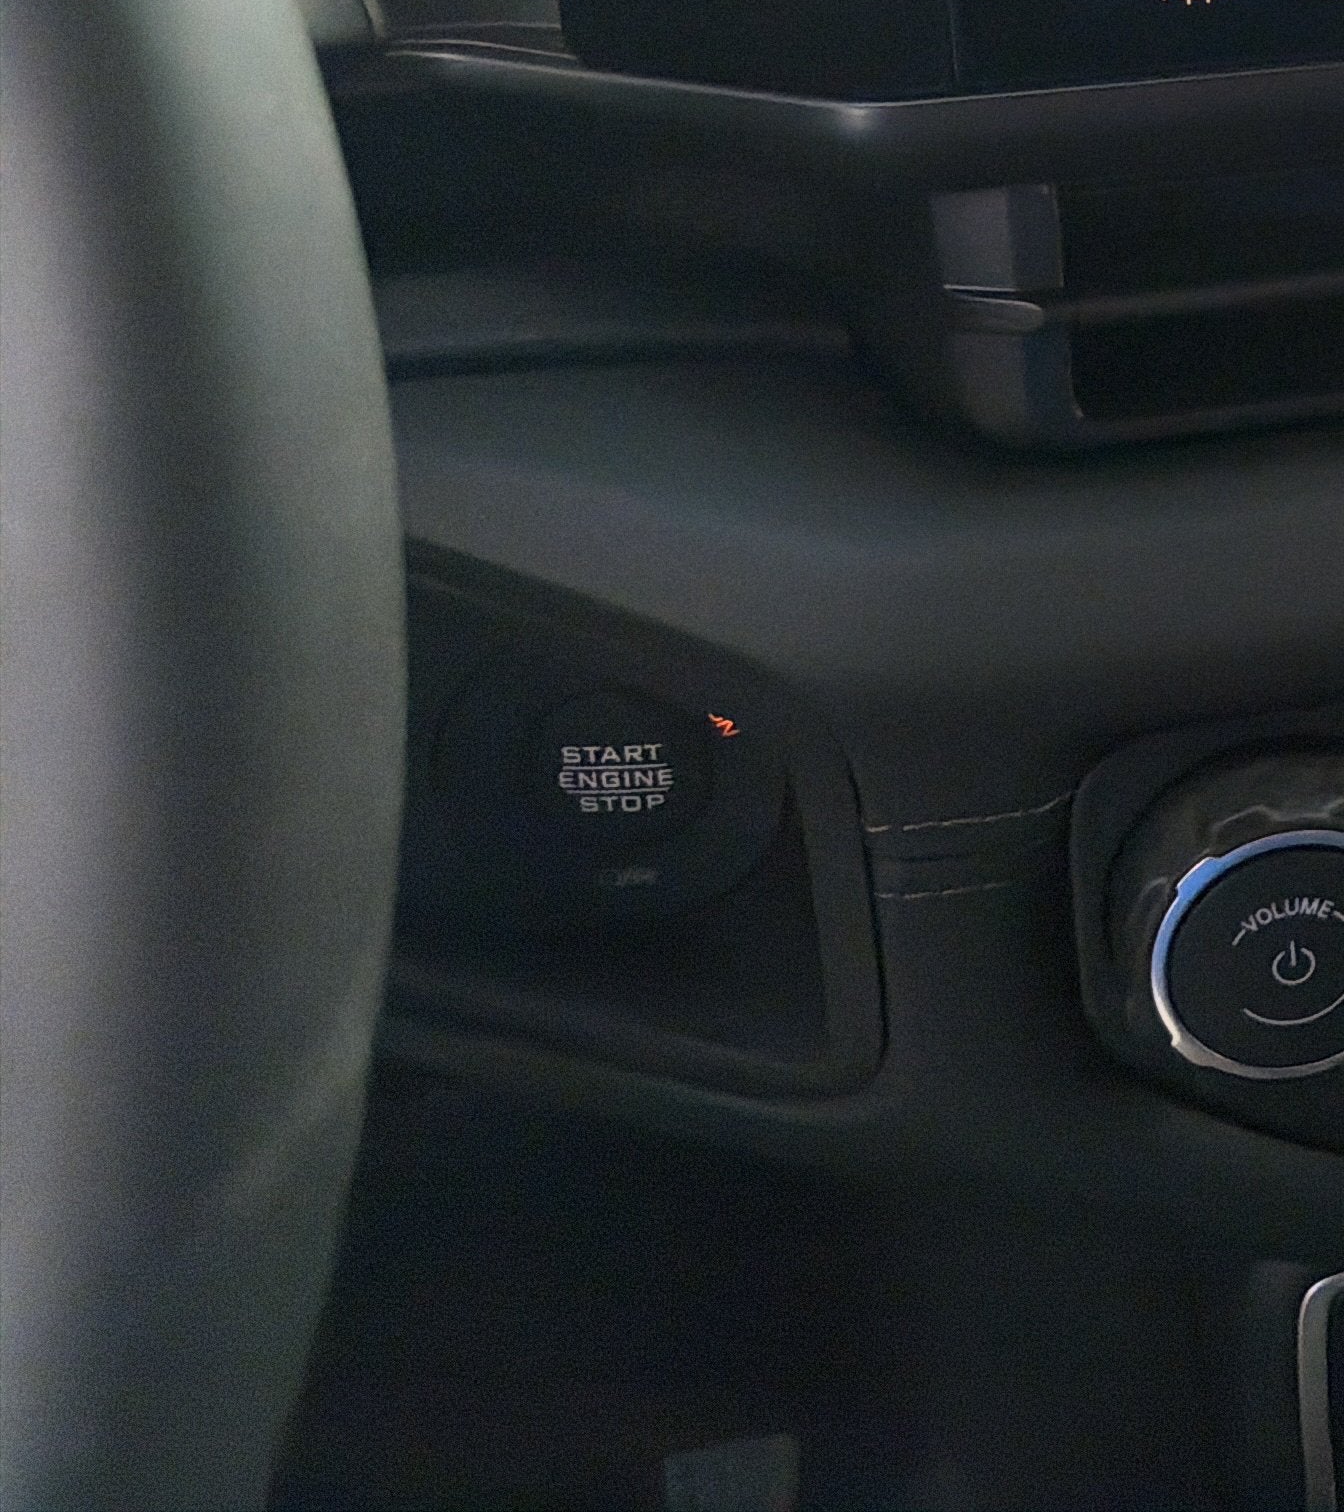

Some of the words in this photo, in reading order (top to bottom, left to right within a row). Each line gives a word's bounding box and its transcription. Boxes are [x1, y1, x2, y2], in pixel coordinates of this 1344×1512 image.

[560, 743, 663, 763] START
[557, 768, 675, 788] ENGINE
[580, 794, 666, 813] STOP
[1241, 898, 1334, 932] VOLUME
